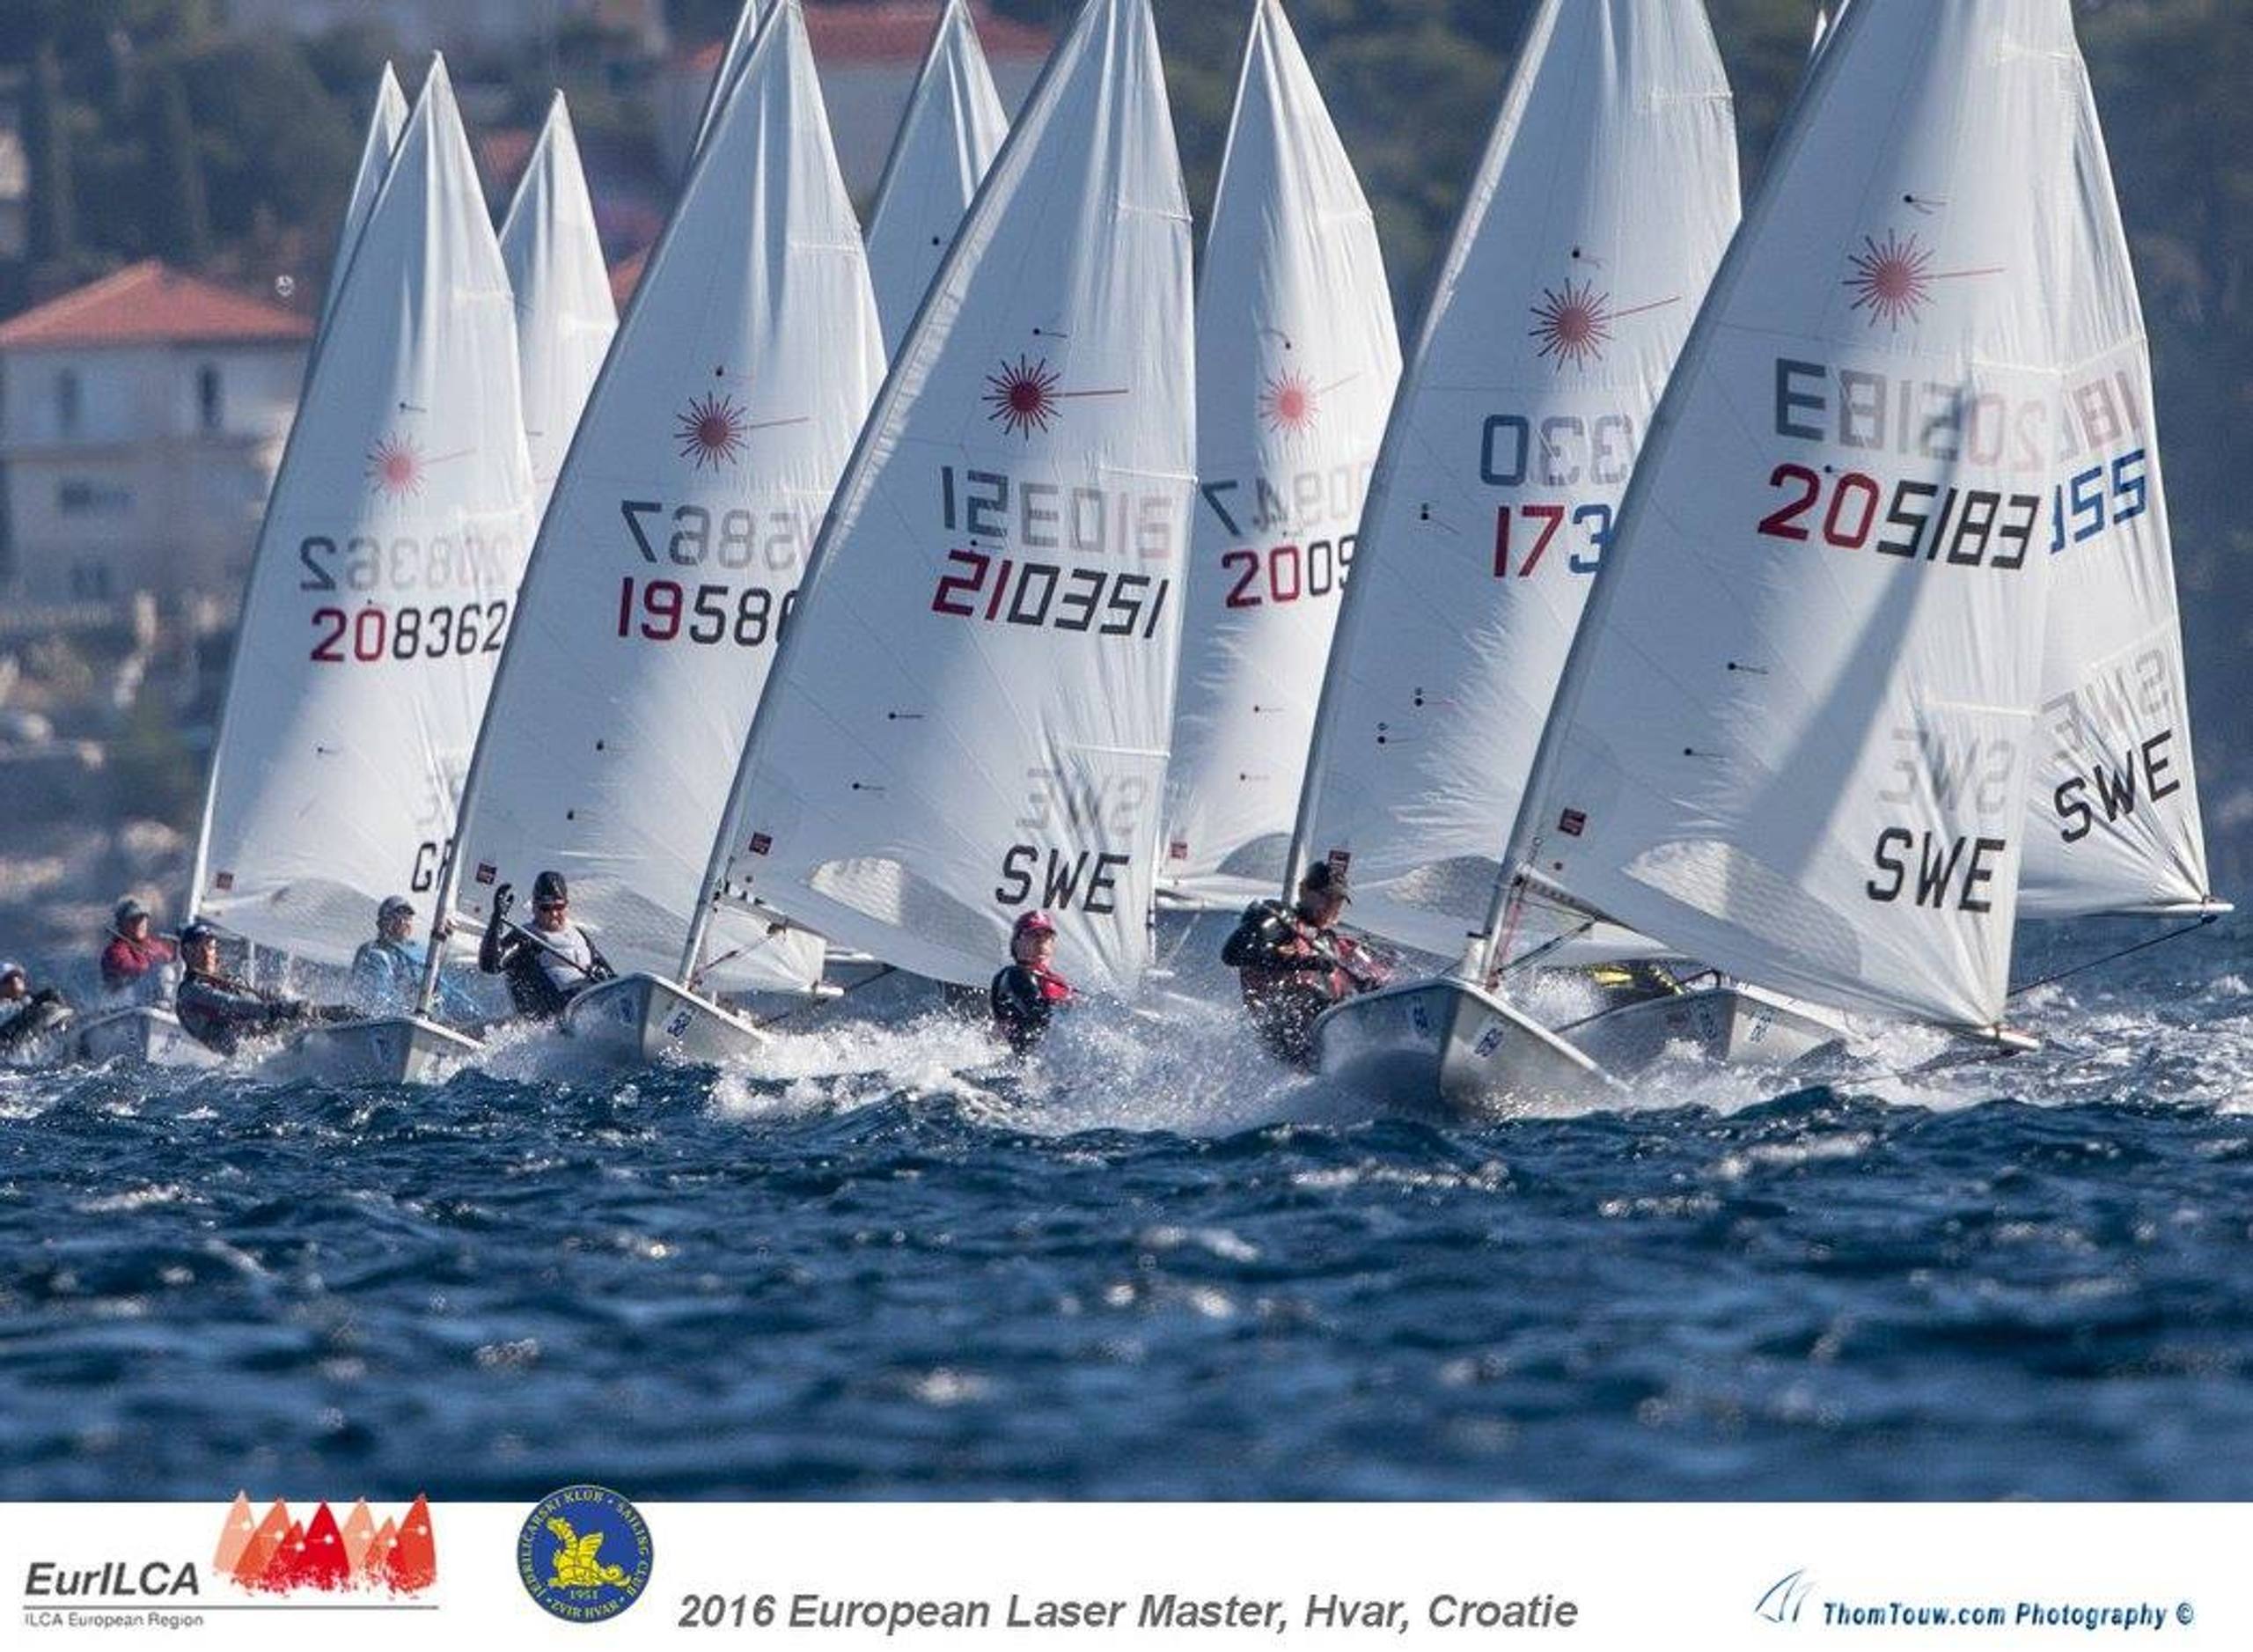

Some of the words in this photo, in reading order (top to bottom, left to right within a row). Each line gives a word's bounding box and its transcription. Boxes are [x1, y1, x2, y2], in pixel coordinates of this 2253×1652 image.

[1493, 503, 1614, 578] 173
[1758, 462, 2040, 570] 205183
[311, 599, 508, 662] 208362
[932, 548, 1168, 638] 210351
[2053, 730, 2181, 843] SWE
[995, 845, 1130, 914] SWE
[1866, 826, 2006, 914] SWE
